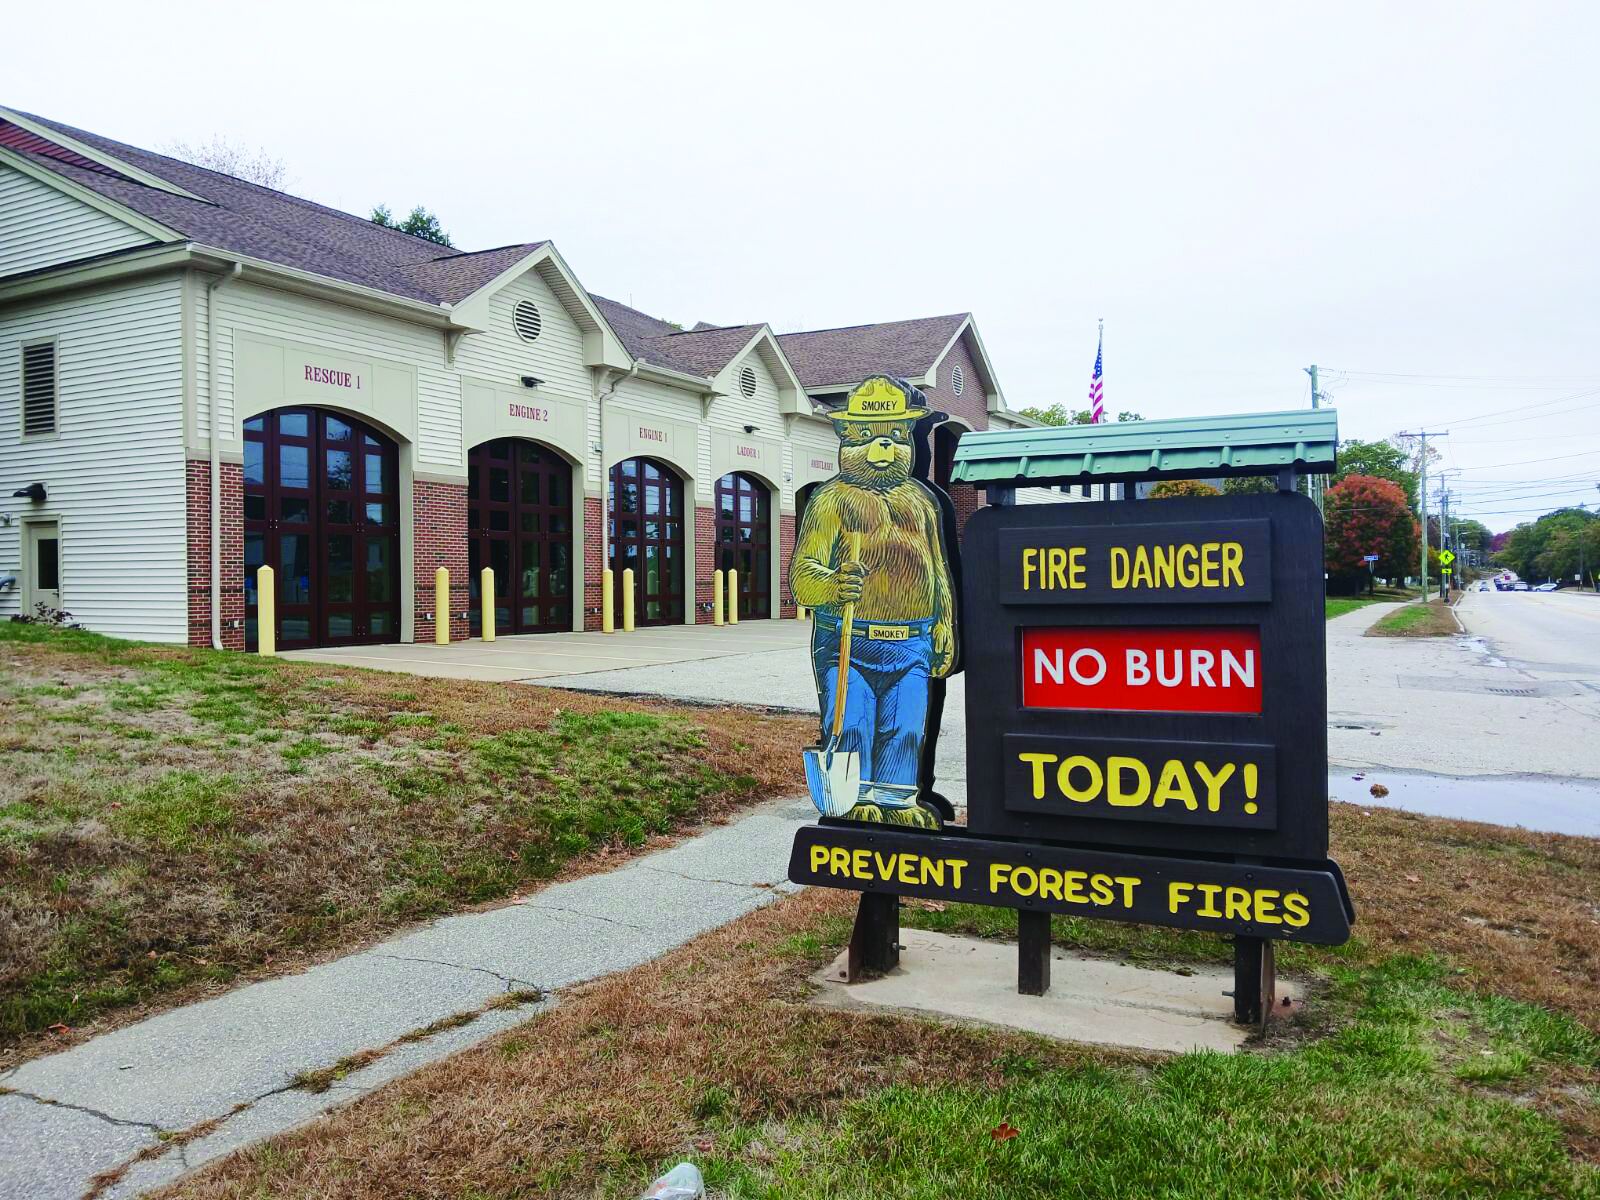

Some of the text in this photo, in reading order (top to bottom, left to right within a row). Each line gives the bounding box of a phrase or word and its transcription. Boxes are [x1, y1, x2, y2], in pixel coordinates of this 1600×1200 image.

[304, 365, 361, 390] RESCUE 1
[509, 403, 548, 422] ENGINE 2
[861, 400, 898, 411] SMOKEY
[639, 427, 663, 442] ENGINE
[1023, 542, 1245, 590] FIRE DANGER
[873, 629, 905, 639] SMOKEY
[1034, 648, 1255, 688] NO BURN
[1018, 752, 1258, 815] TODAY!
[810, 844, 1310, 927] PREVENT FOREST FIRES
